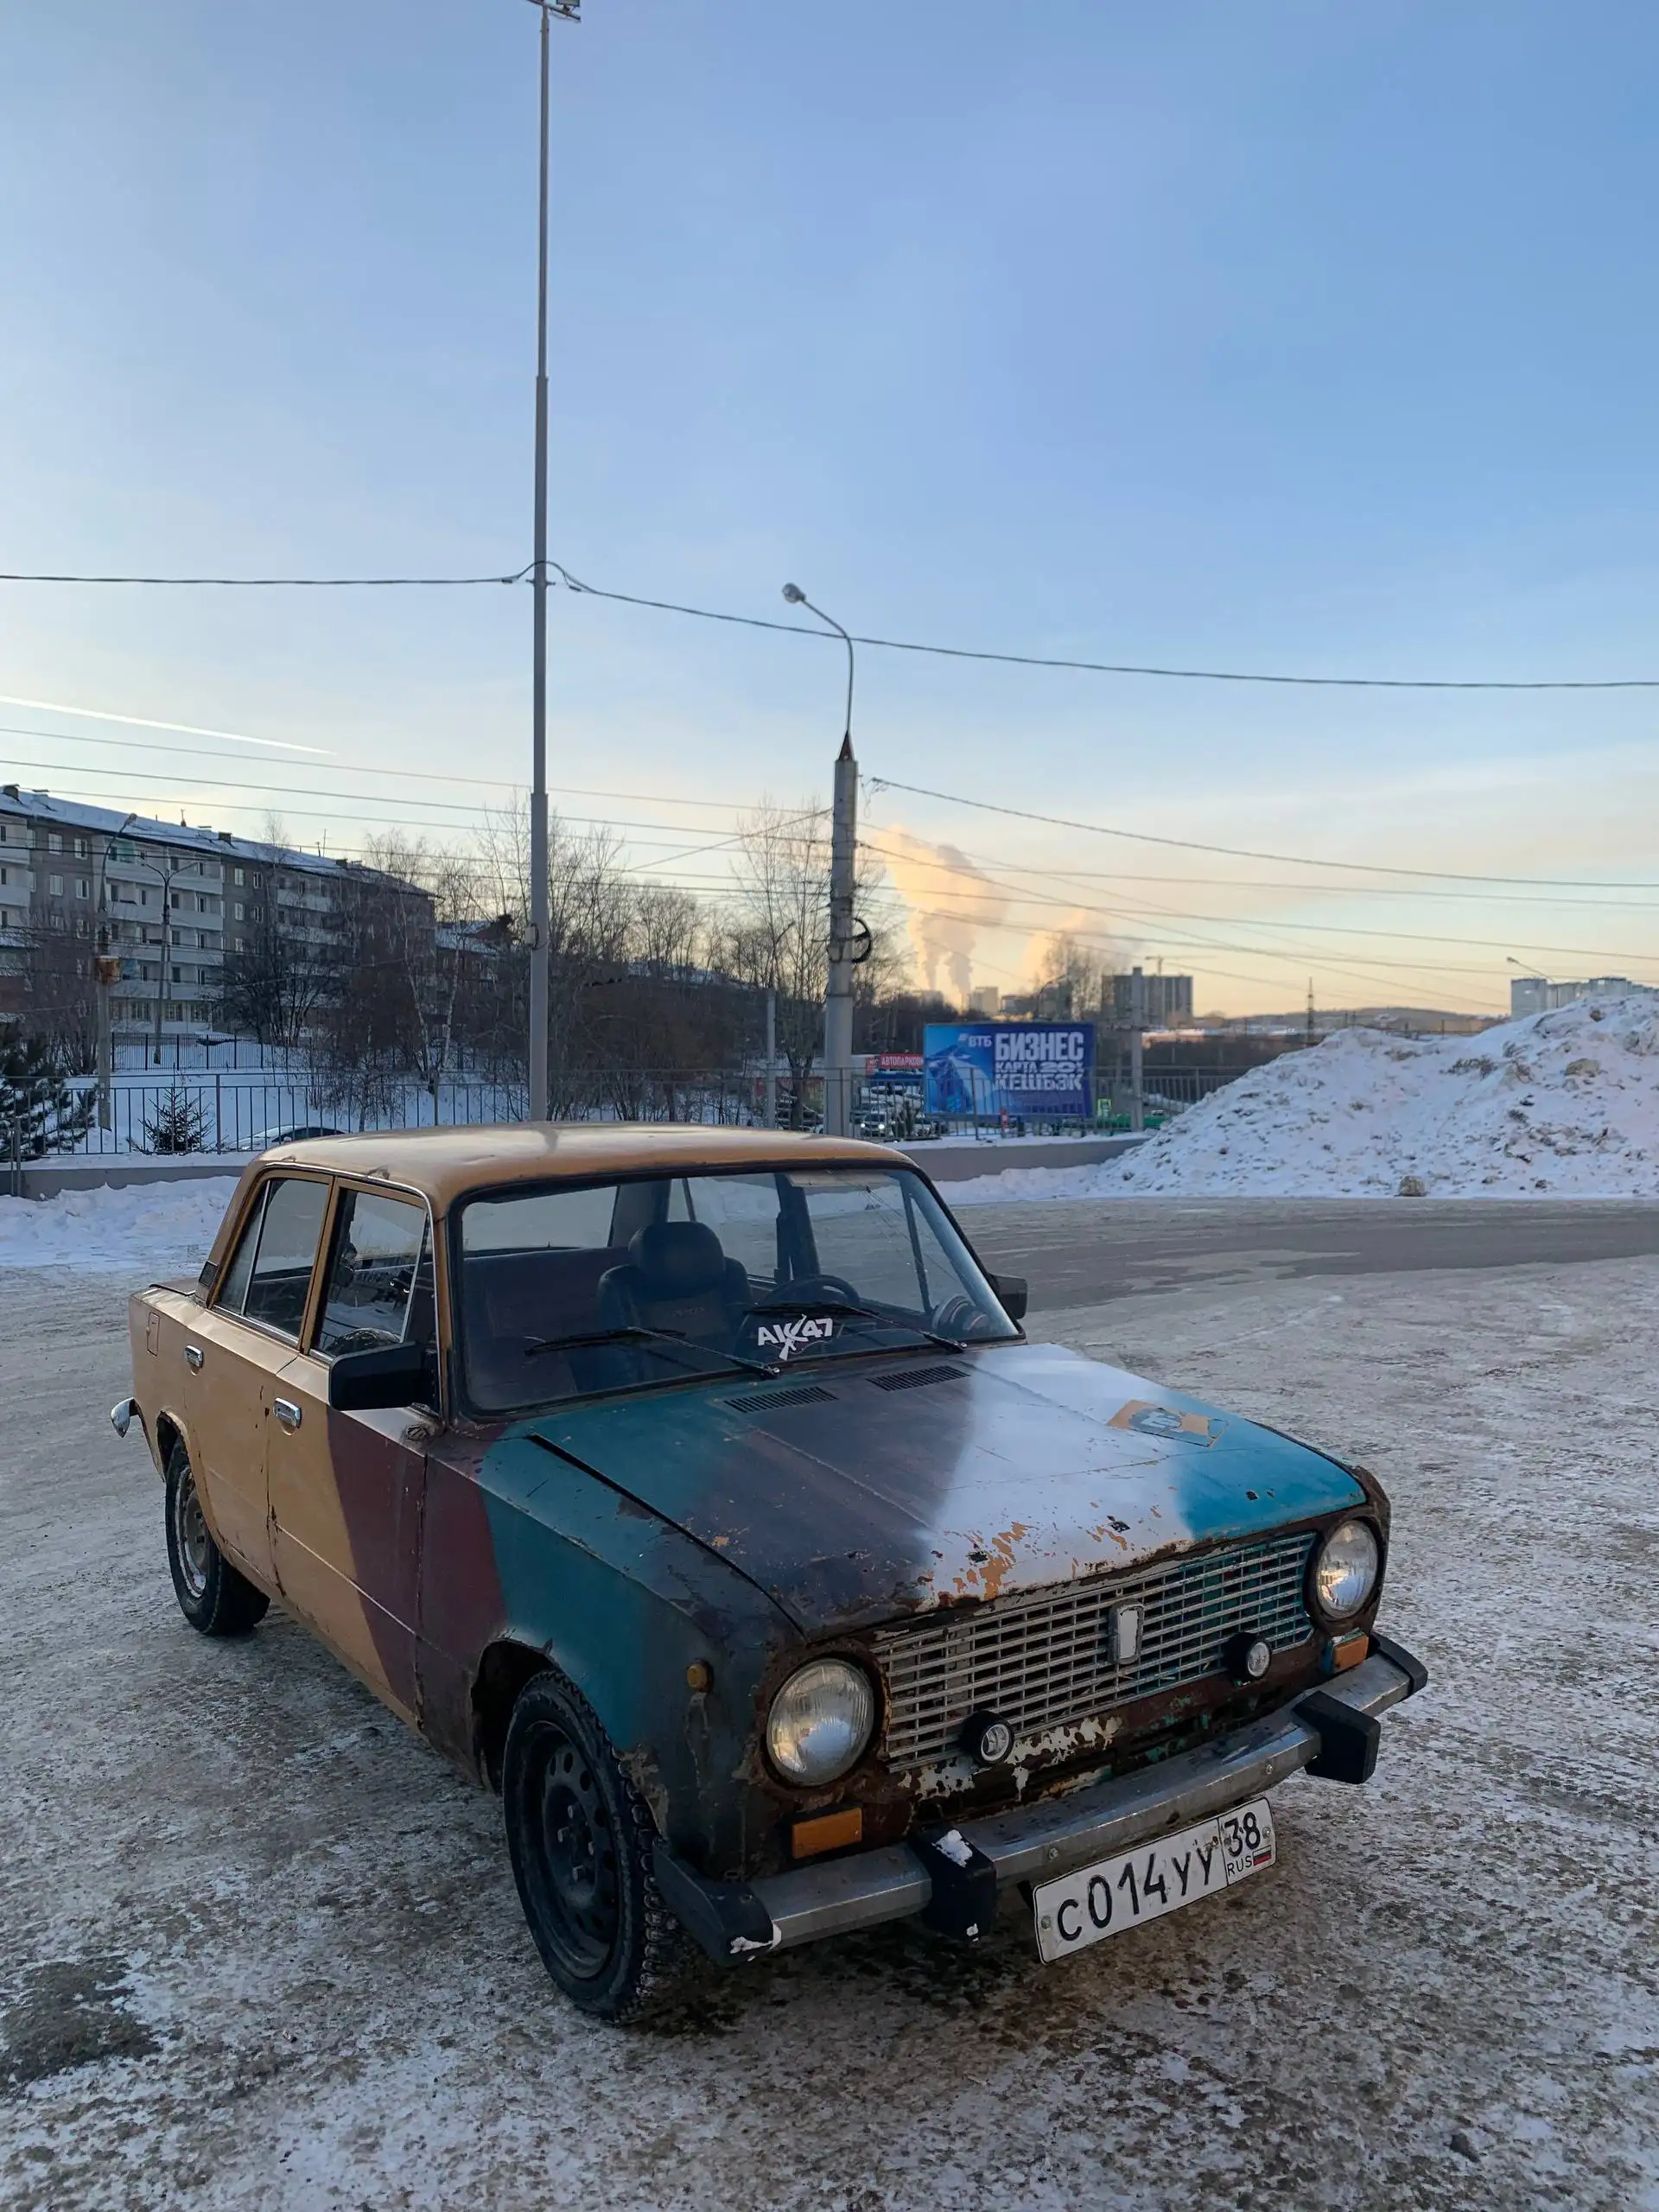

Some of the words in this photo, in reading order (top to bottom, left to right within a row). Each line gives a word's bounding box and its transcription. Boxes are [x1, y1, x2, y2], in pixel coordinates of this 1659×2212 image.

[969, 1034, 993, 1048] ВТБ
[995, 1032, 1084, 1061] БИЗНЕС
[995, 1061, 1037, 1073] КАРТА
[995, 1073, 1084, 1090] КЕШБЭК
[1224, 1812, 1261, 1857] 38
[1227, 1857, 1253, 1878] RUS
